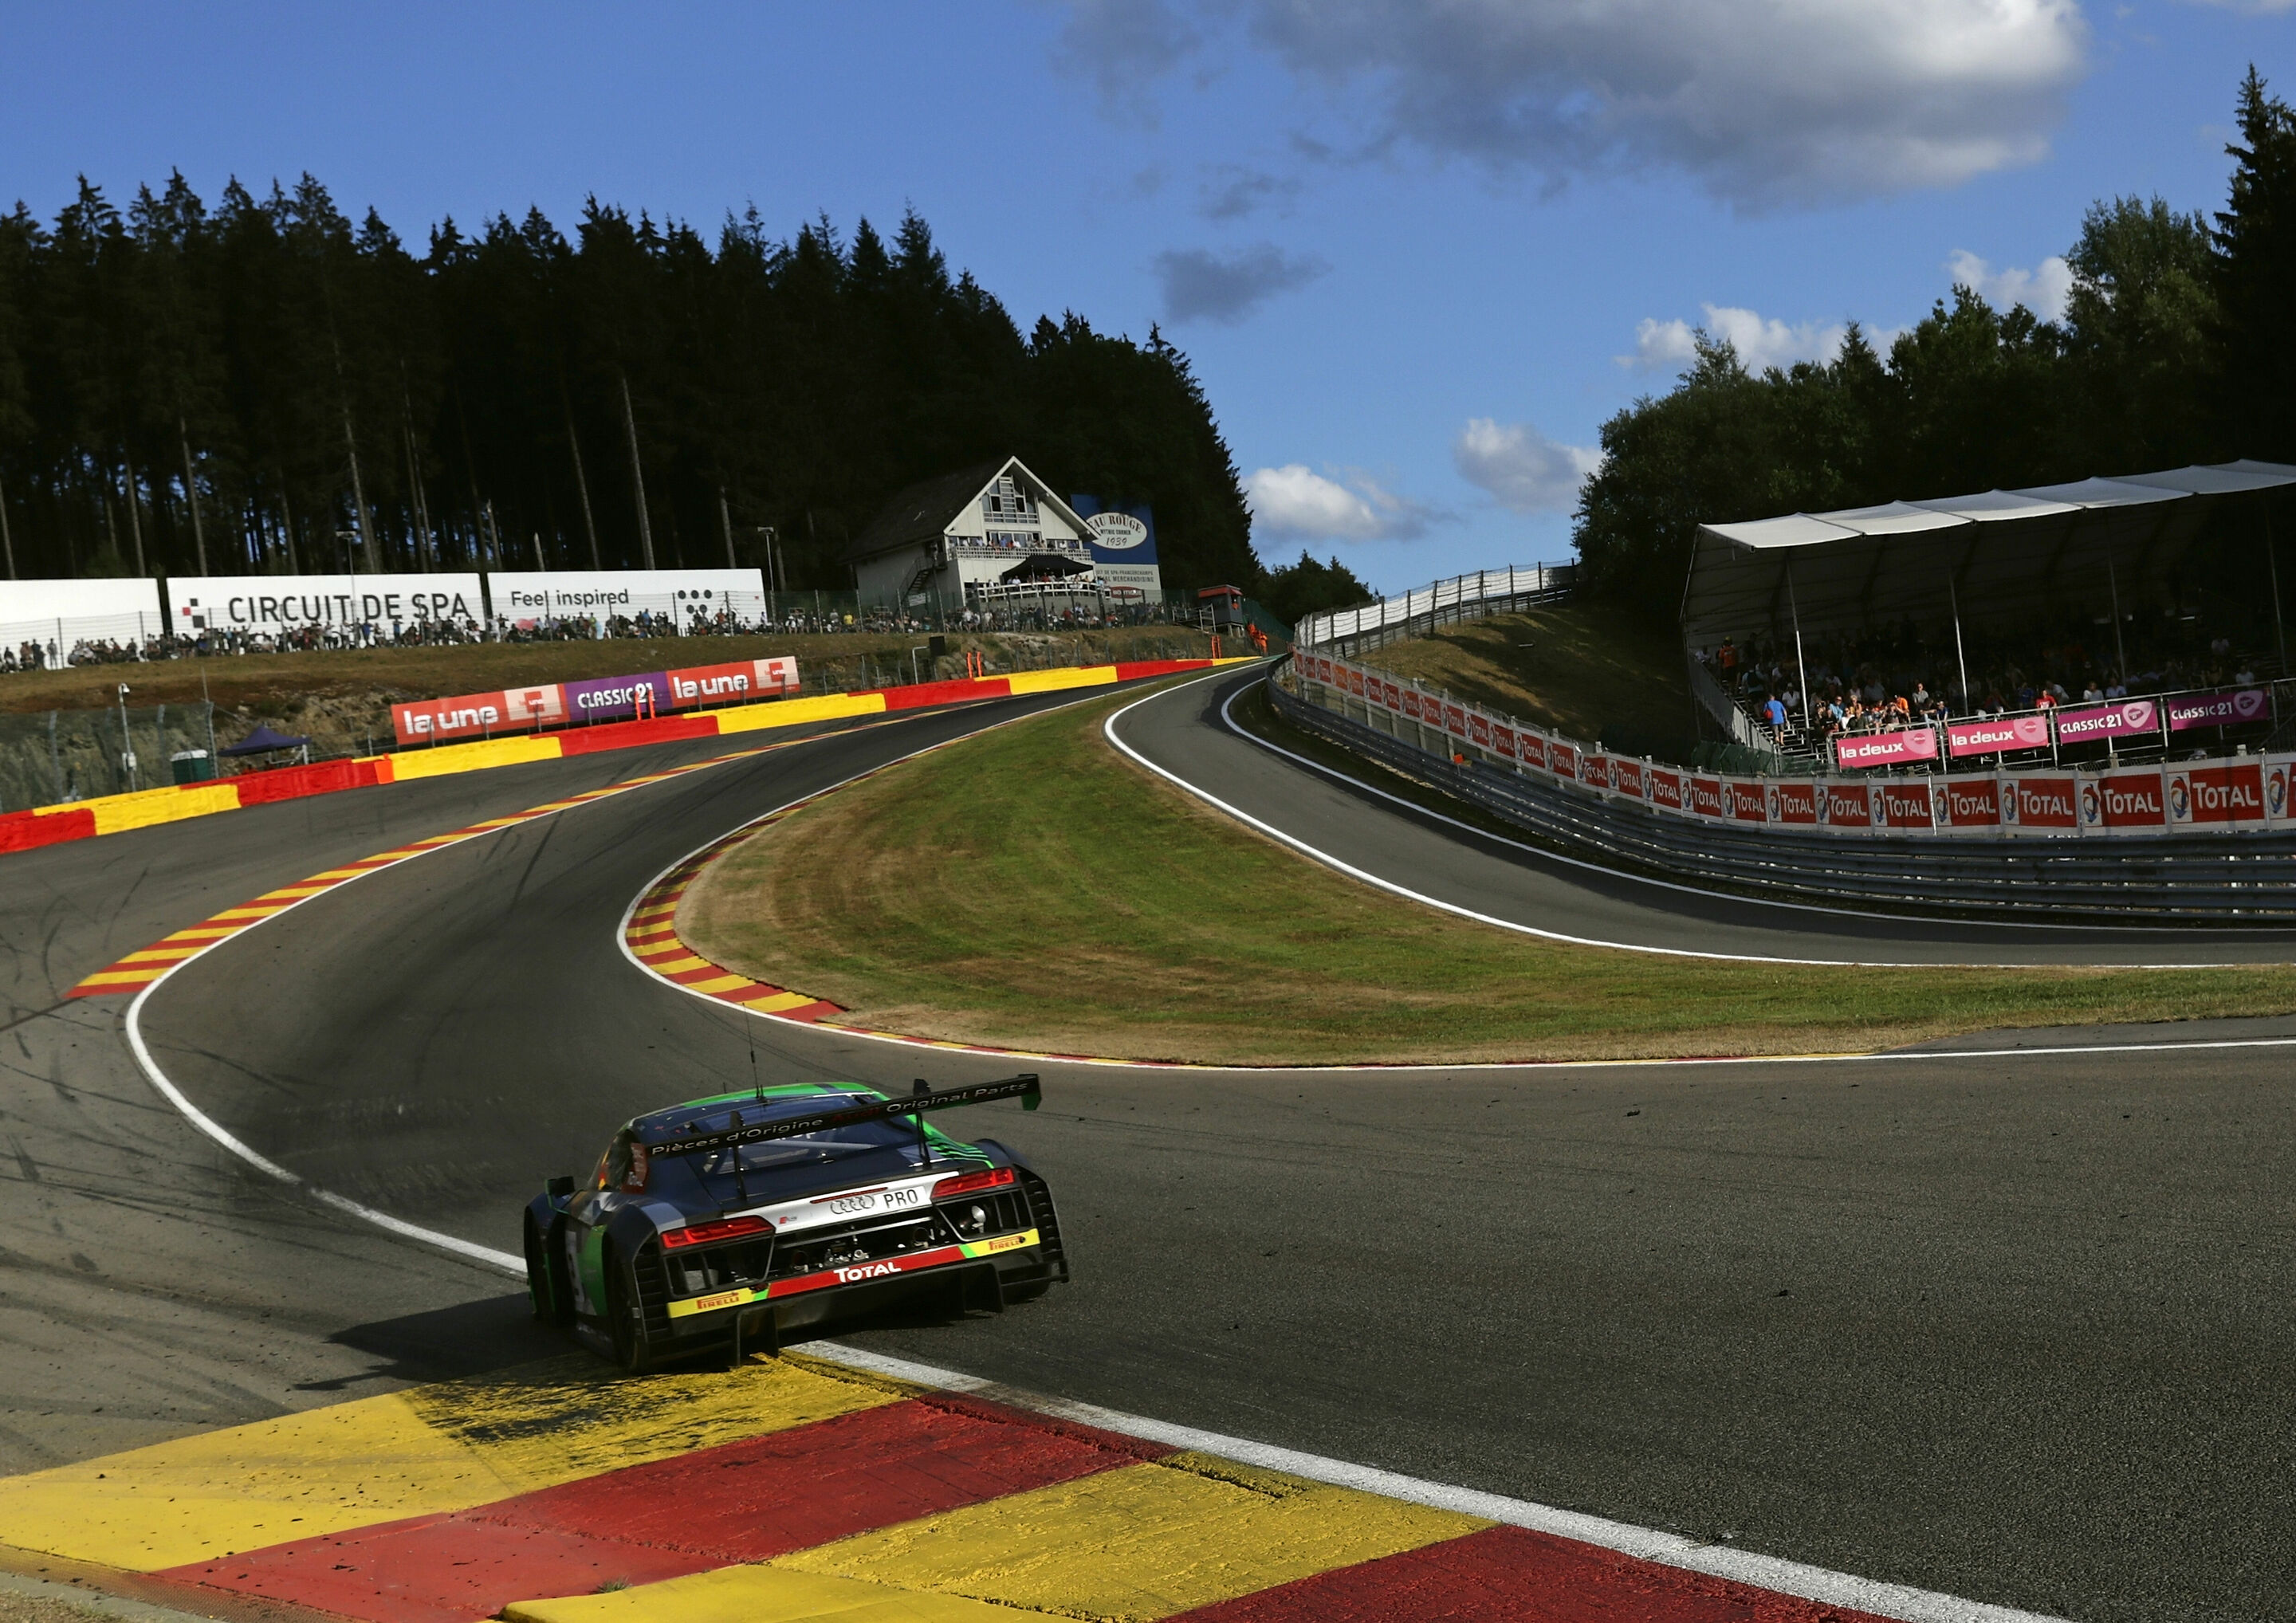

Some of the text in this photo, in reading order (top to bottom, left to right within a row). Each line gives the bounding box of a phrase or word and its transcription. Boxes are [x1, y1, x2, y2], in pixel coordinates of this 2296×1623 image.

[1089, 515, 1142, 533] AU ROUGE
[1106, 537, 1127, 546] 1939
[228, 592, 470, 623] CIRCUIT DE SPA
[511, 588, 629, 608] Feel inspired
[673, 674, 749, 699] la une
[577, 688, 634, 709] CLASSIC
[403, 705, 499, 734] la une
[1447, 711, 1464, 730] TOTAL
[2171, 707, 2216, 721] CLASSIC
[2217, 701, 2233, 715] 21
[1472, 721, 1488, 741] TOTAL
[2060, 717, 2105, 734] CLASSIC
[2106, 713, 2122, 728] 21
[1495, 731, 1514, 751] TOTAL
[1952, 730, 2014, 747] la deux
[1523, 741, 1544, 761] TOTAL
[1554, 750, 1574, 771] TOTAL
[1840, 742, 1904, 759] la deux
[1583, 760, 1608, 781] TOTAL
[1618, 768, 1641, 789] TOTAL
[1653, 777, 1680, 800] TOTAL
[1693, 786, 1721, 809] TOTAL
[2192, 782, 2260, 810] TOTAL
[1735, 792, 1765, 813] TOTAL
[1781, 792, 1814, 814] TOTAL
[1830, 795, 1868, 816] TOTAL
[1886, 796, 1928, 817] TOTAL
[1950, 792, 1996, 815] TOTAL
[2020, 790, 2074, 815] TOTAL
[2103, 788, 2161, 815] TOTAL
[651, 1138, 719, 1155] Pièces
[886, 1092, 968, 1113] Original
[974, 1082, 1028, 1098] Parts
[883, 1189, 918, 1209] PRO
[989, 1236, 1022, 1250] PIRELL
[833, 1261, 902, 1283] TOTAL
[696, 1291, 740, 1309] PIRELLI
